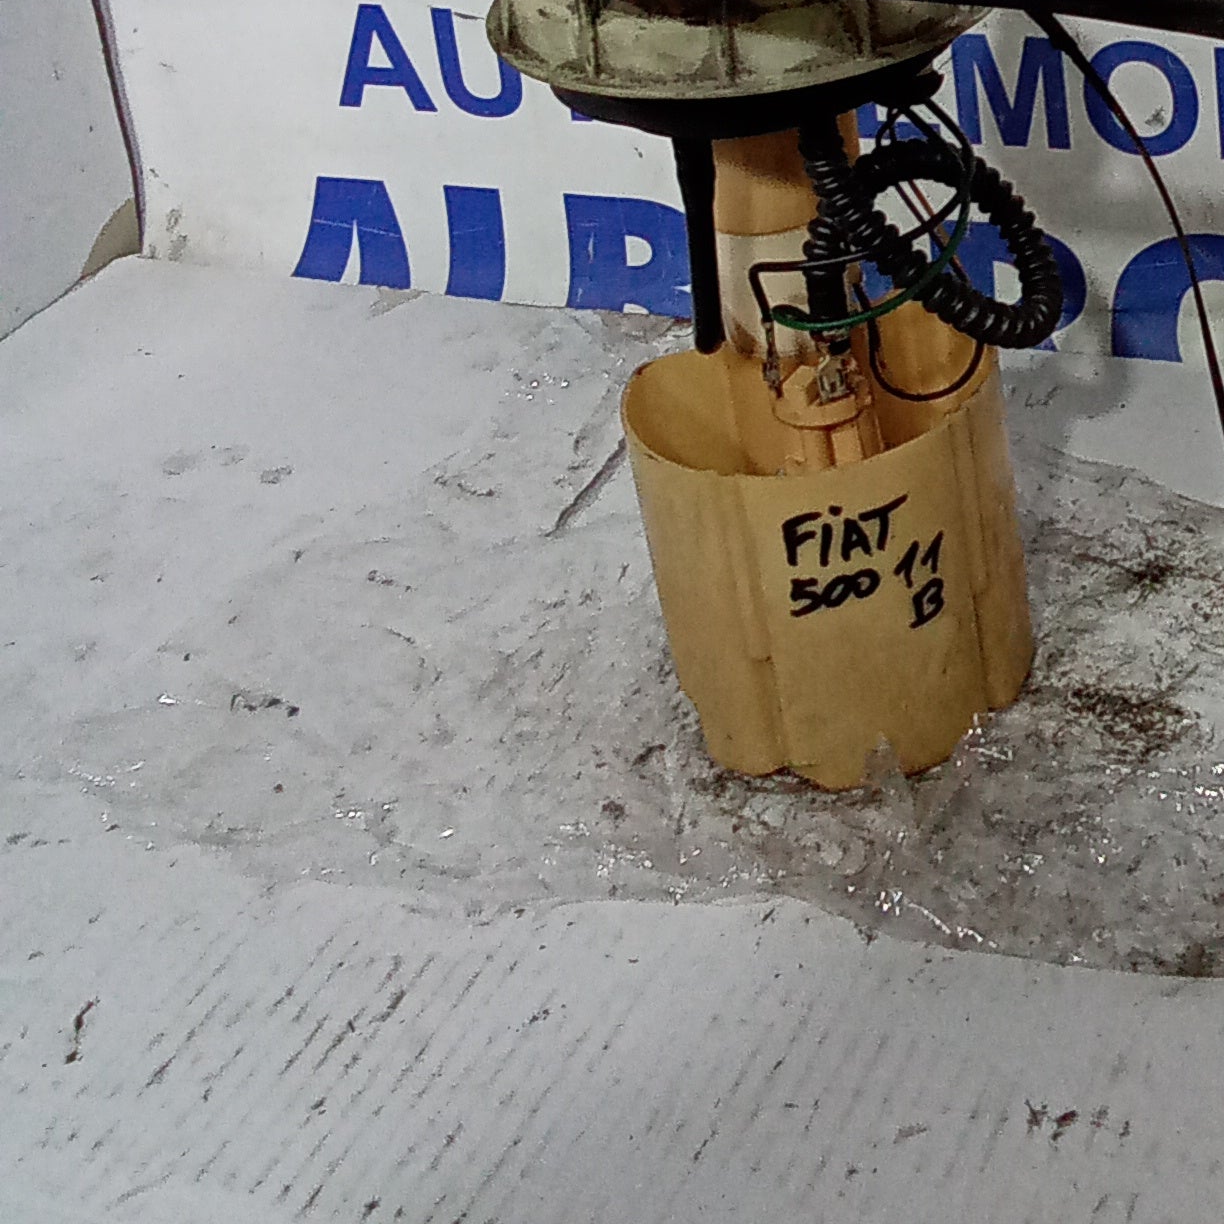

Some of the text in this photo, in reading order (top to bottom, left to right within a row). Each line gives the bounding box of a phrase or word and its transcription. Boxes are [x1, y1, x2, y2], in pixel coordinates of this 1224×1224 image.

[790, 530, 944, 618] 500 11
[908, 577, 945, 629] B
